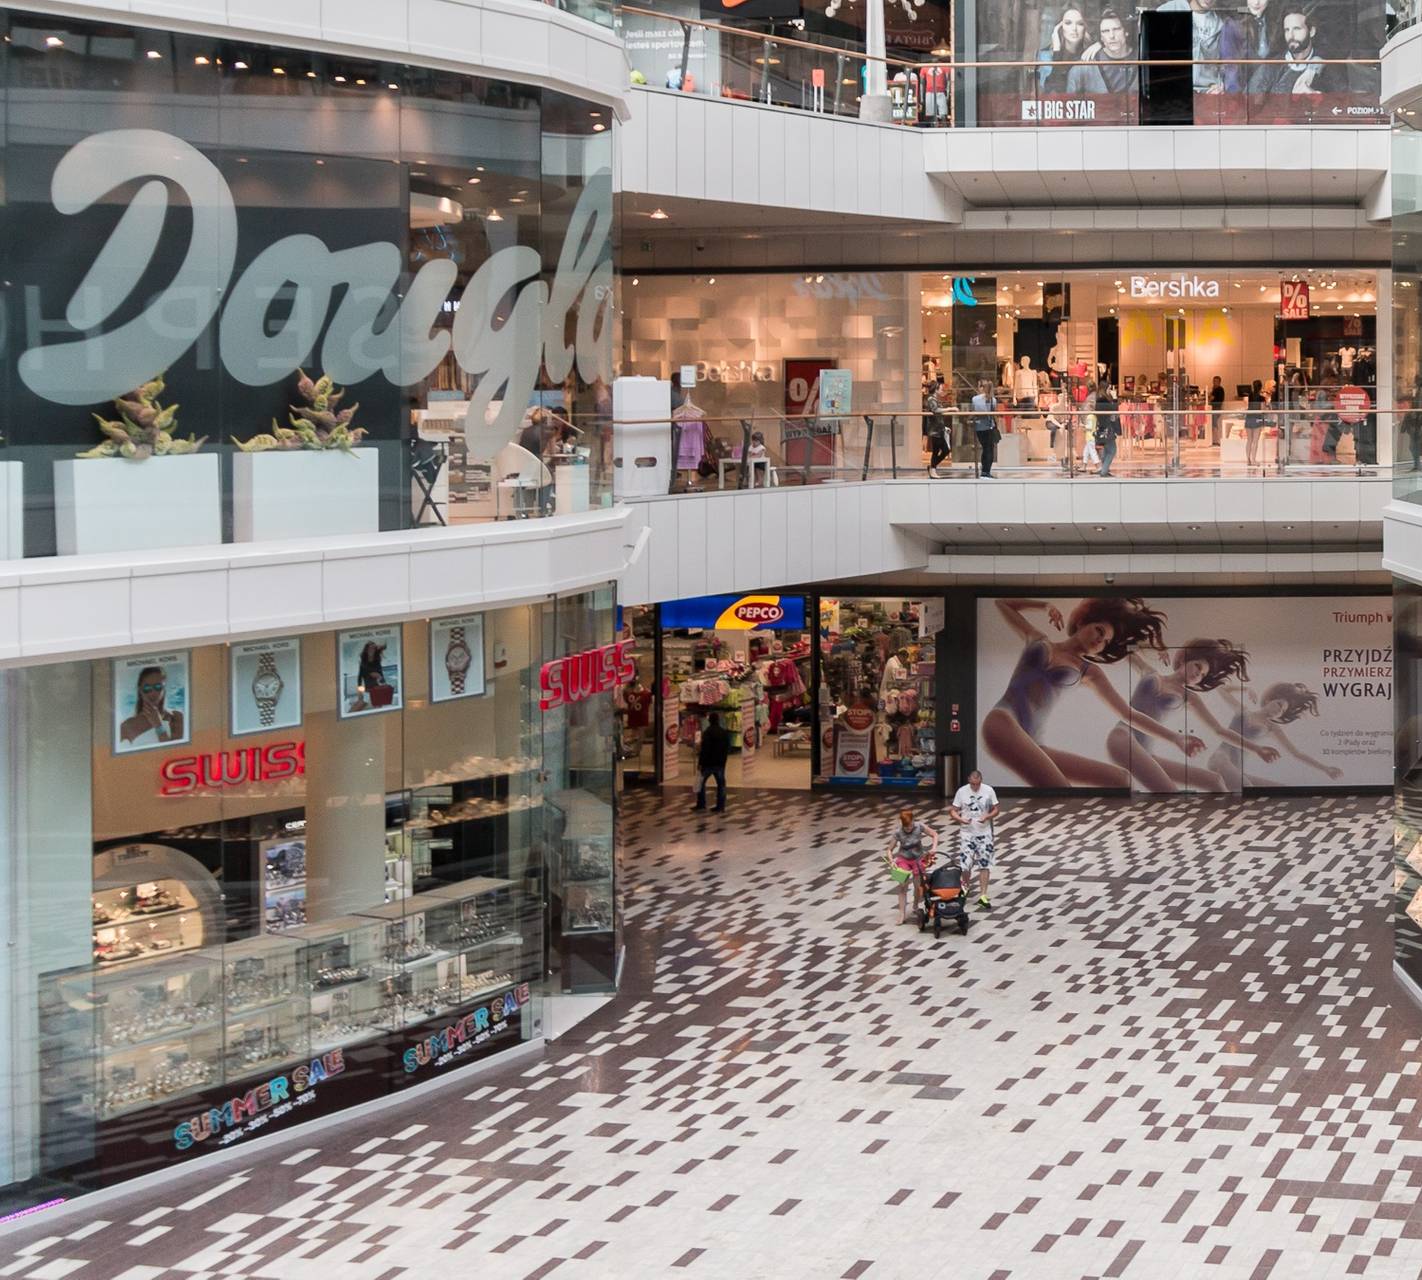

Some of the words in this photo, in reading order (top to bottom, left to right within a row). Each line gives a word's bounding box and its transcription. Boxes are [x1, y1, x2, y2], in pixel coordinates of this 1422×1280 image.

[1044, 100, 1063, 119] BIG
[1066, 100, 1095, 119] STAR
[1347, 107, 1375, 115] POZIOM
[1131, 276, 1219, 298] Bershka
[1281, 308, 1308, 319] SALE
[738, 606, 779, 619] PEPCO
[1332, 612, 1383, 625] Triumph
[1323, 646, 1393, 665] PRZYJDŹ
[539, 638, 636, 711] SWISS
[1323, 667, 1393, 678] PRZYMIERZ
[1323, 683, 1393, 700] WYGRAJ
[161, 741, 305, 795] SWIS
[403, 1007, 490, 1073] SUMMER
[491, 982, 529, 1022] SALE
[174, 1076, 290, 1150] SUMMER
[292, 1048, 346, 1093] SALE
